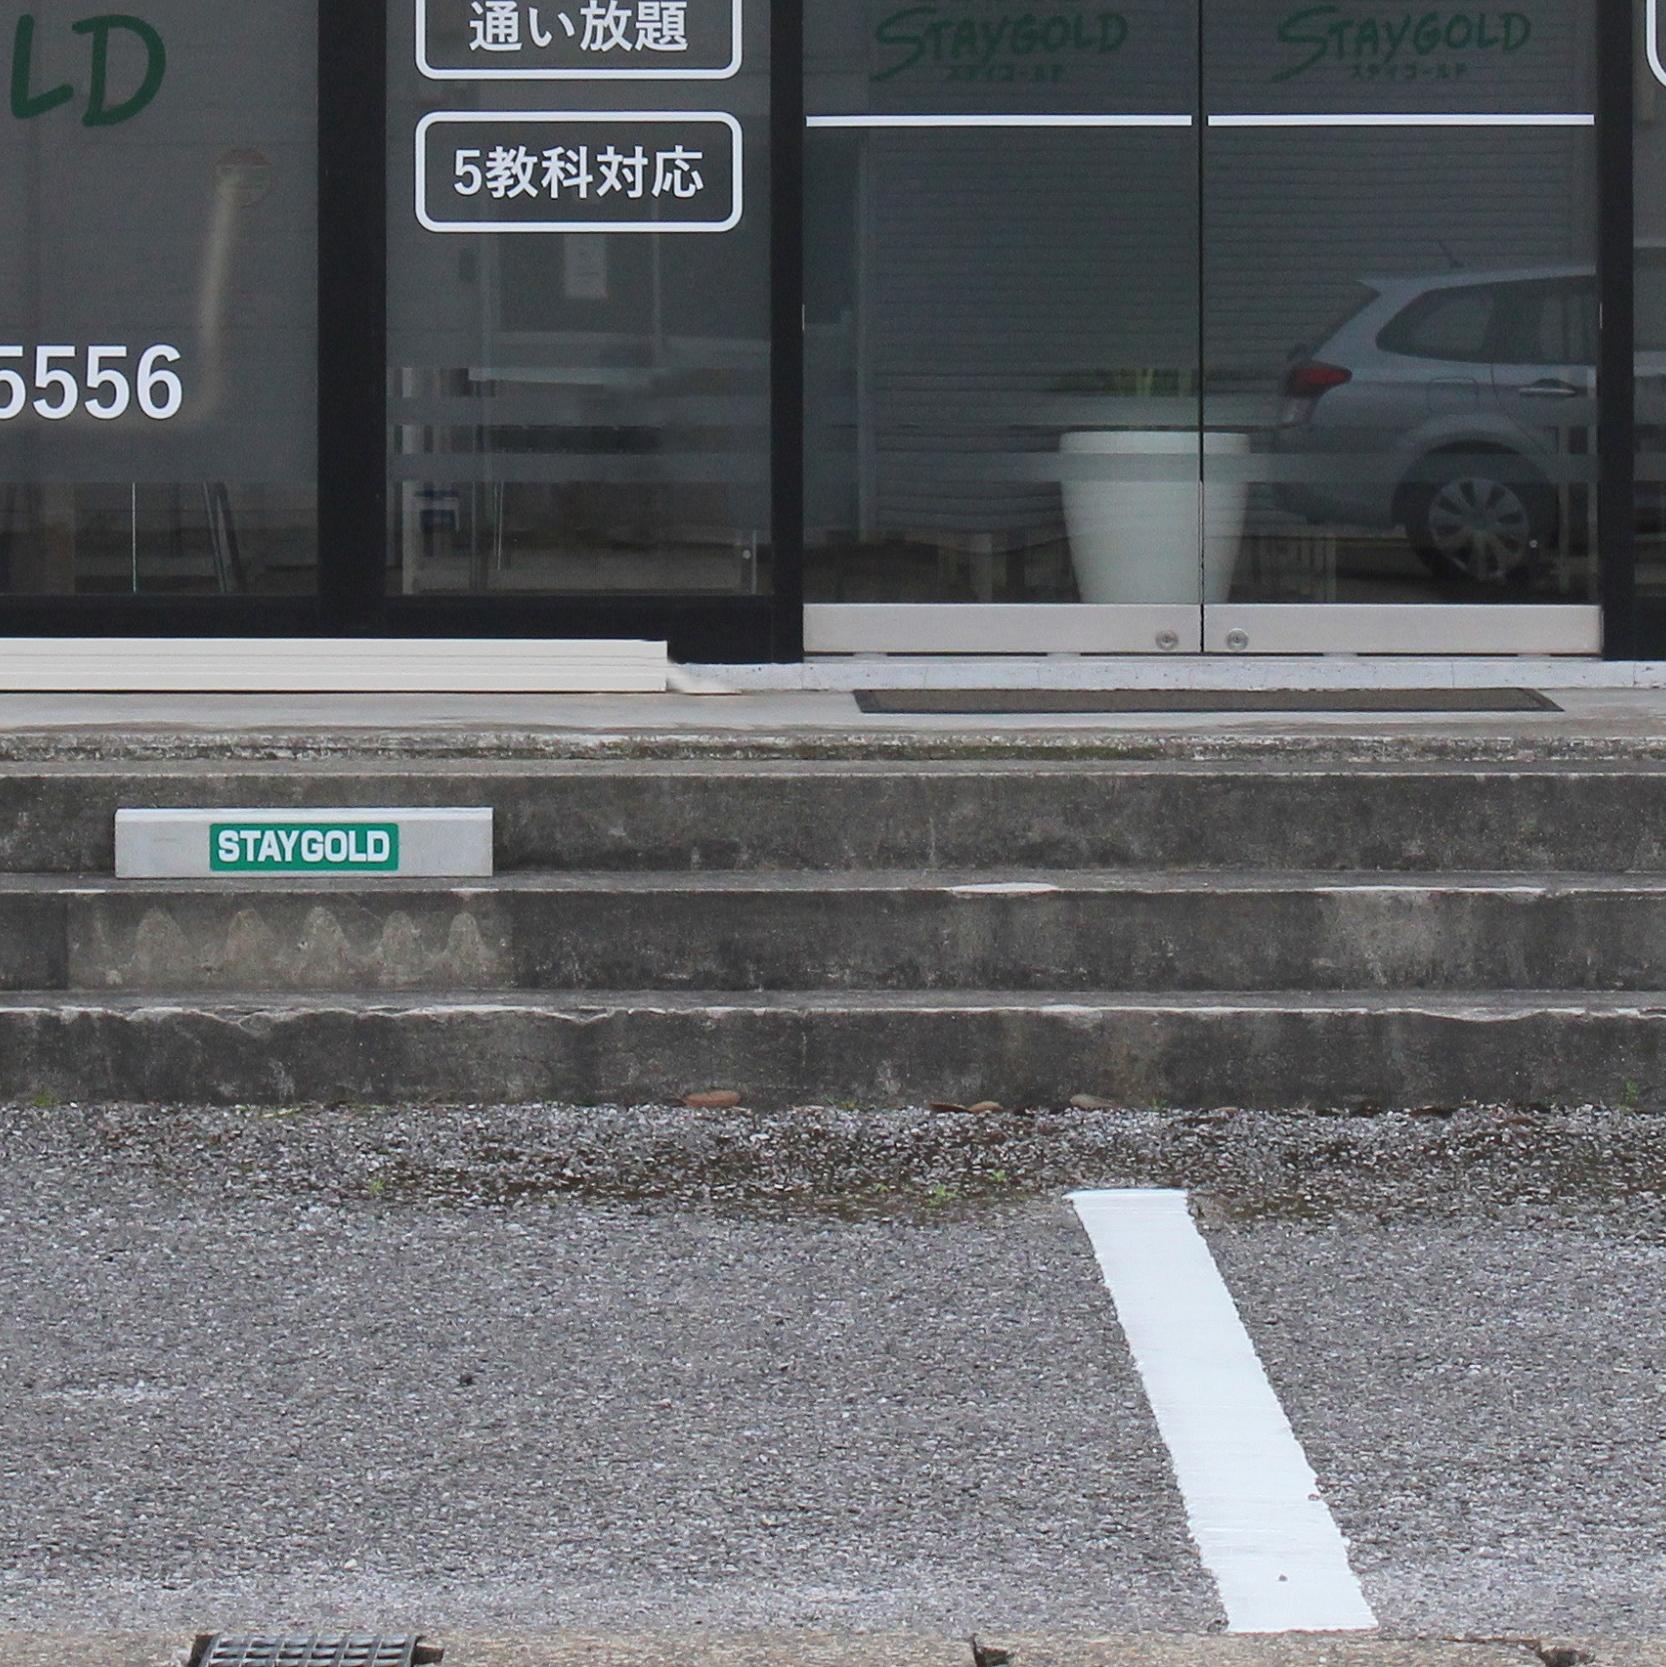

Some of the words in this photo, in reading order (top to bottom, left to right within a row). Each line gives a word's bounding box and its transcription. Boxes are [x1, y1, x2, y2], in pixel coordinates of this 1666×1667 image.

[469, 0, 689, 52] 通い放題
[454, 145, 704, 199] 5教科対応
[218, 830, 390, 862] STAYGOLD
